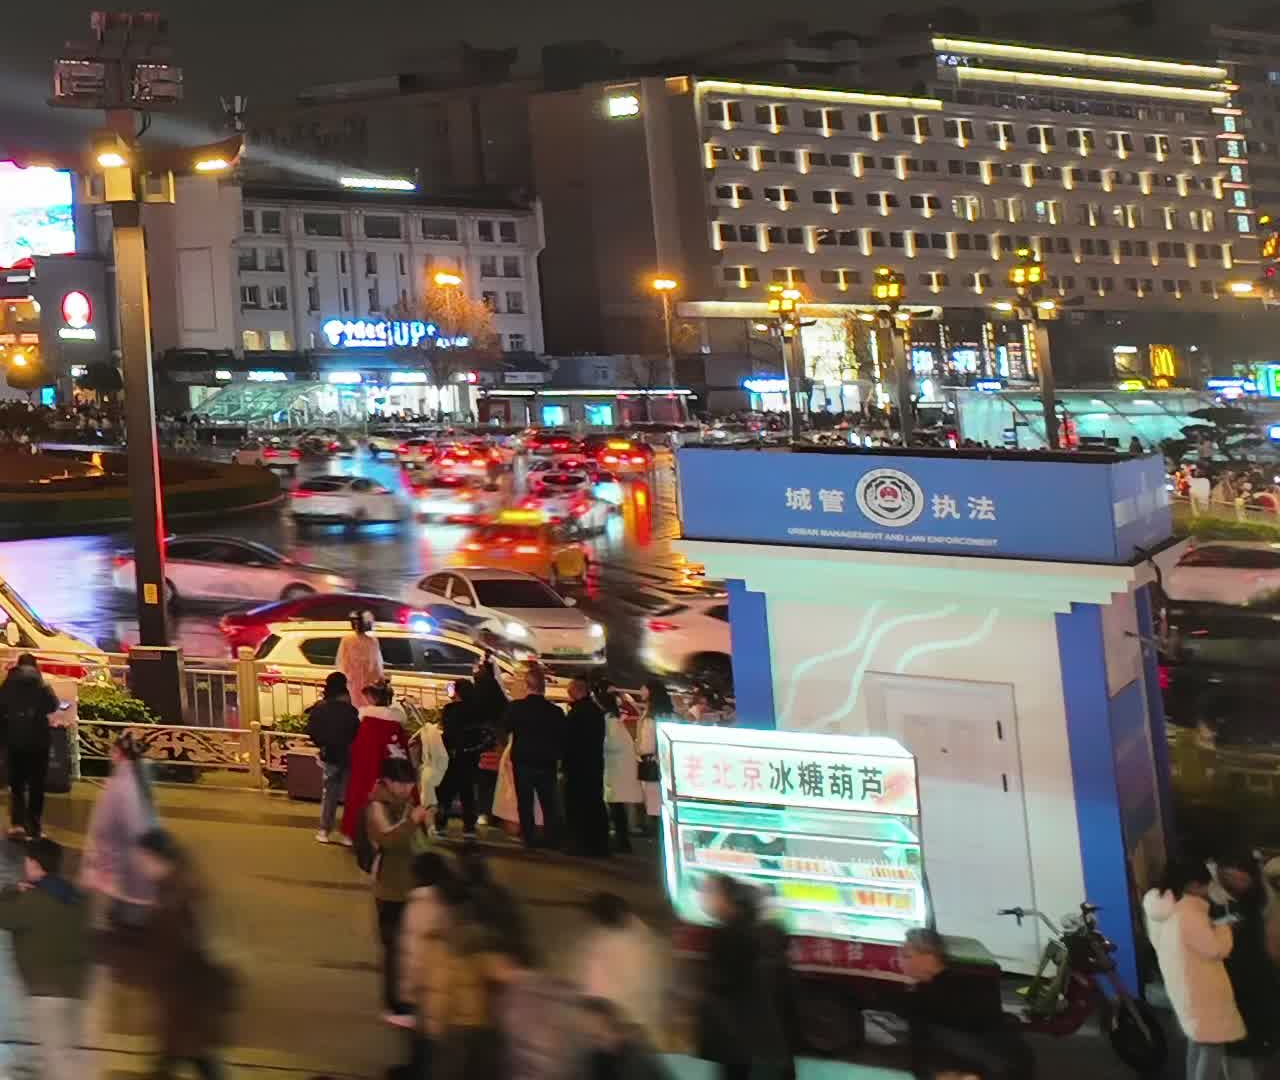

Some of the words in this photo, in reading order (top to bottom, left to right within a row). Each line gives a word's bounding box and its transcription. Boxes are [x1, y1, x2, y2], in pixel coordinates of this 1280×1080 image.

[785, 487, 845, 513] 城管
[931, 494, 997, 520] 执法
[885, 533, 904, 541] AND
[681, 754, 883, 801] 老北京冰糖葫芦
